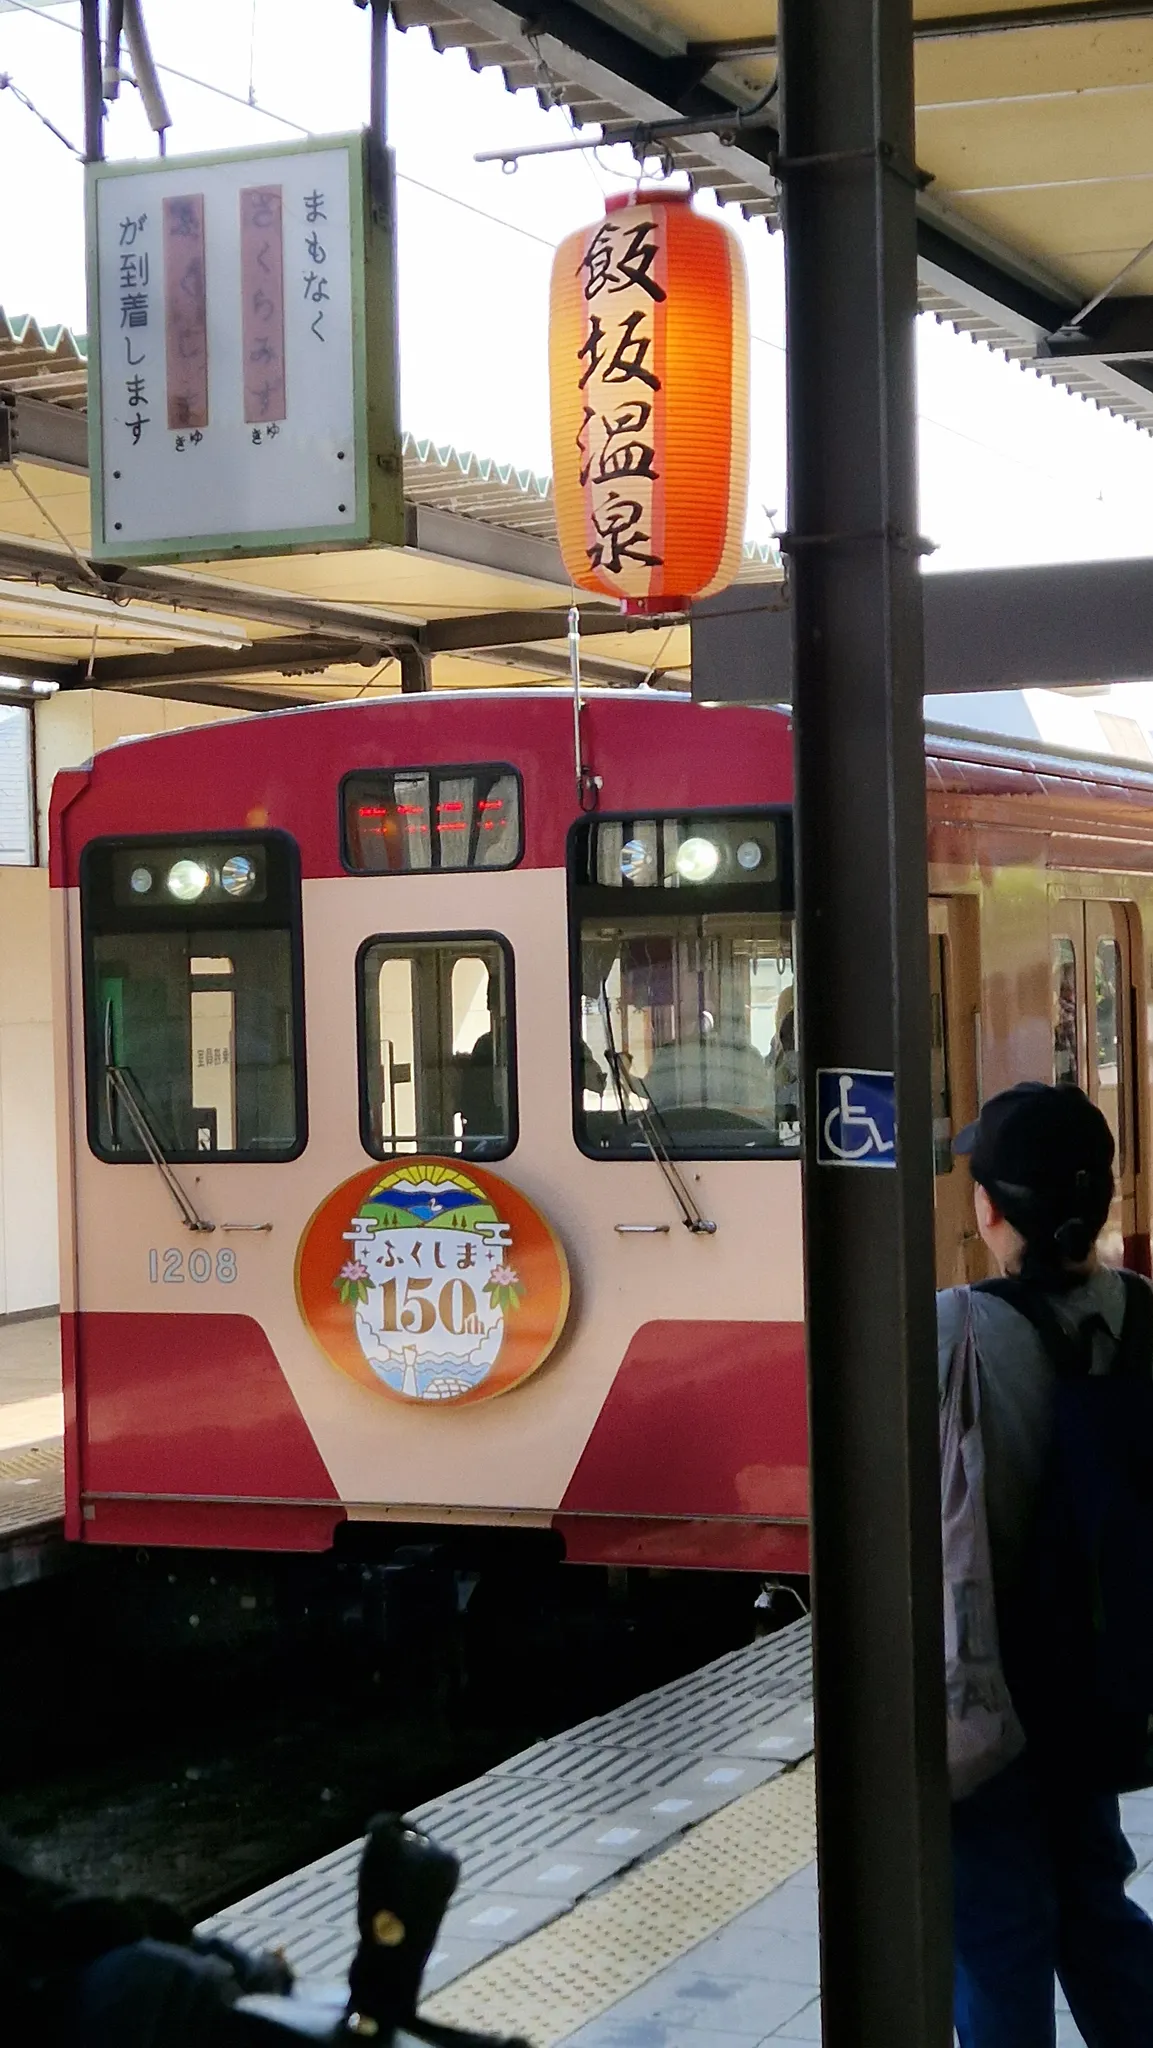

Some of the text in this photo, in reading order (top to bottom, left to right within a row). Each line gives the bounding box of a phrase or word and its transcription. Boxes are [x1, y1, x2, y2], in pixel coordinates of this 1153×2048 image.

[302, 189, 331, 343] まもなく
[118, 214, 151, 446] が到着します
[575, 221, 667, 574] 飯坂温泉
[149, 1247, 238, 1284] 1208
[376, 1240, 477, 1270] ふくしま
[378, 1277, 485, 1335] 150th
